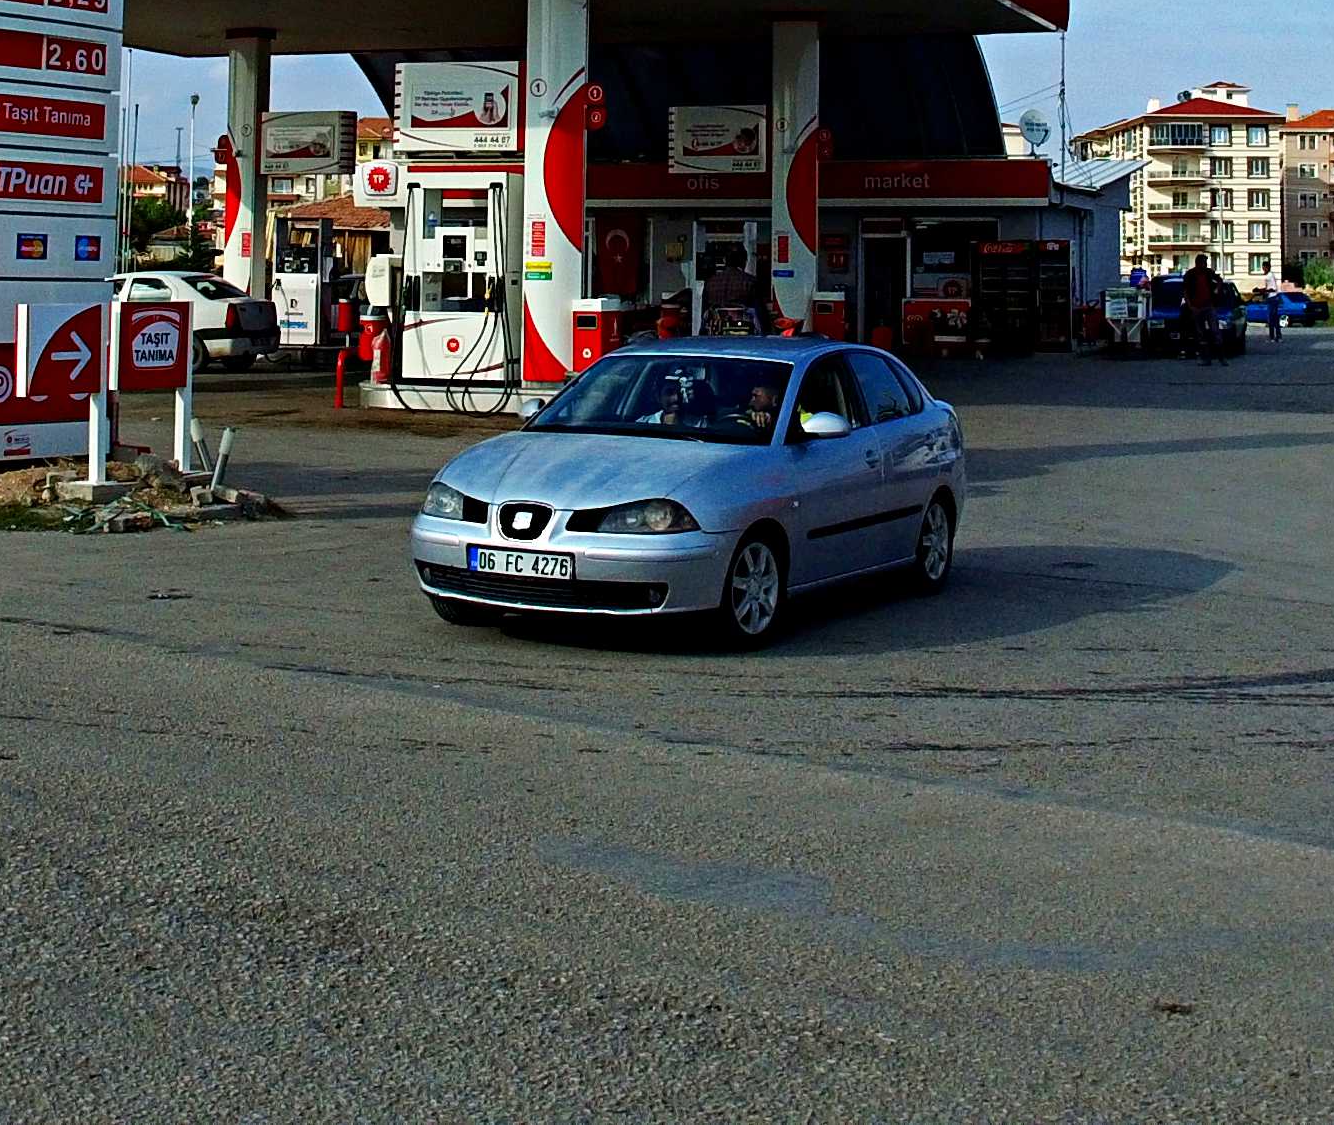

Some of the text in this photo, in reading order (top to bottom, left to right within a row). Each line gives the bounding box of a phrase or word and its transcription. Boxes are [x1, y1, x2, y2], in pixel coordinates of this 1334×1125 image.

[48, 43, 104, 71] 2,60
[3, 102, 39, 124] Taşıt
[44, 106, 91, 126] Tanıma
[372, 174, 385, 184] TP
[687, 175, 720, 190] ofis
[864, 173, 930, 189] market
[140, 332, 171, 347] TAŞIT
[134, 349, 175, 362] TANIMA
[479, 551, 496, 570] 06
[505, 553, 524, 573] FC
[531, 556, 569, 577] 4276
